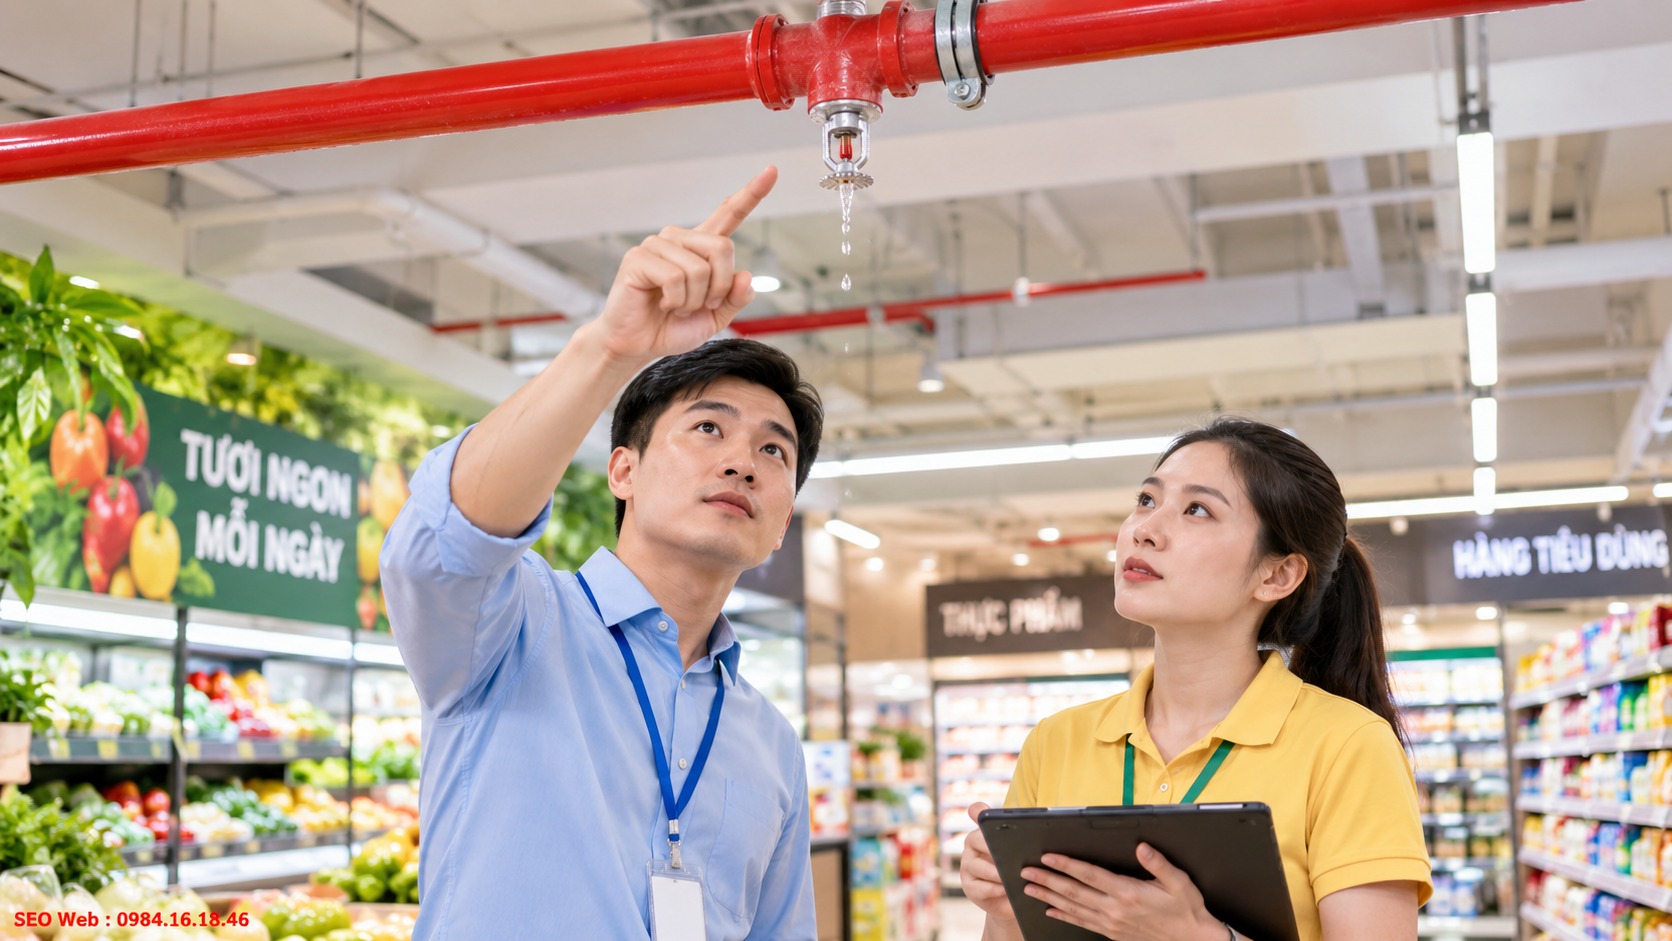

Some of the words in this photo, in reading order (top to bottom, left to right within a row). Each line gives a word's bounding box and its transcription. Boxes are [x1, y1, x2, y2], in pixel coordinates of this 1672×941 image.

[180, 428, 261, 496] TƯƠI
[266, 453, 351, 519] NGON
[195, 497, 259, 568] MỖI
[264, 522, 344, 583] NGÀY
[1453, 532, 1531, 579] HÀNG
[1532, 526, 1592, 574] TIÊU
[1595, 524, 1669, 571] DÙNG
